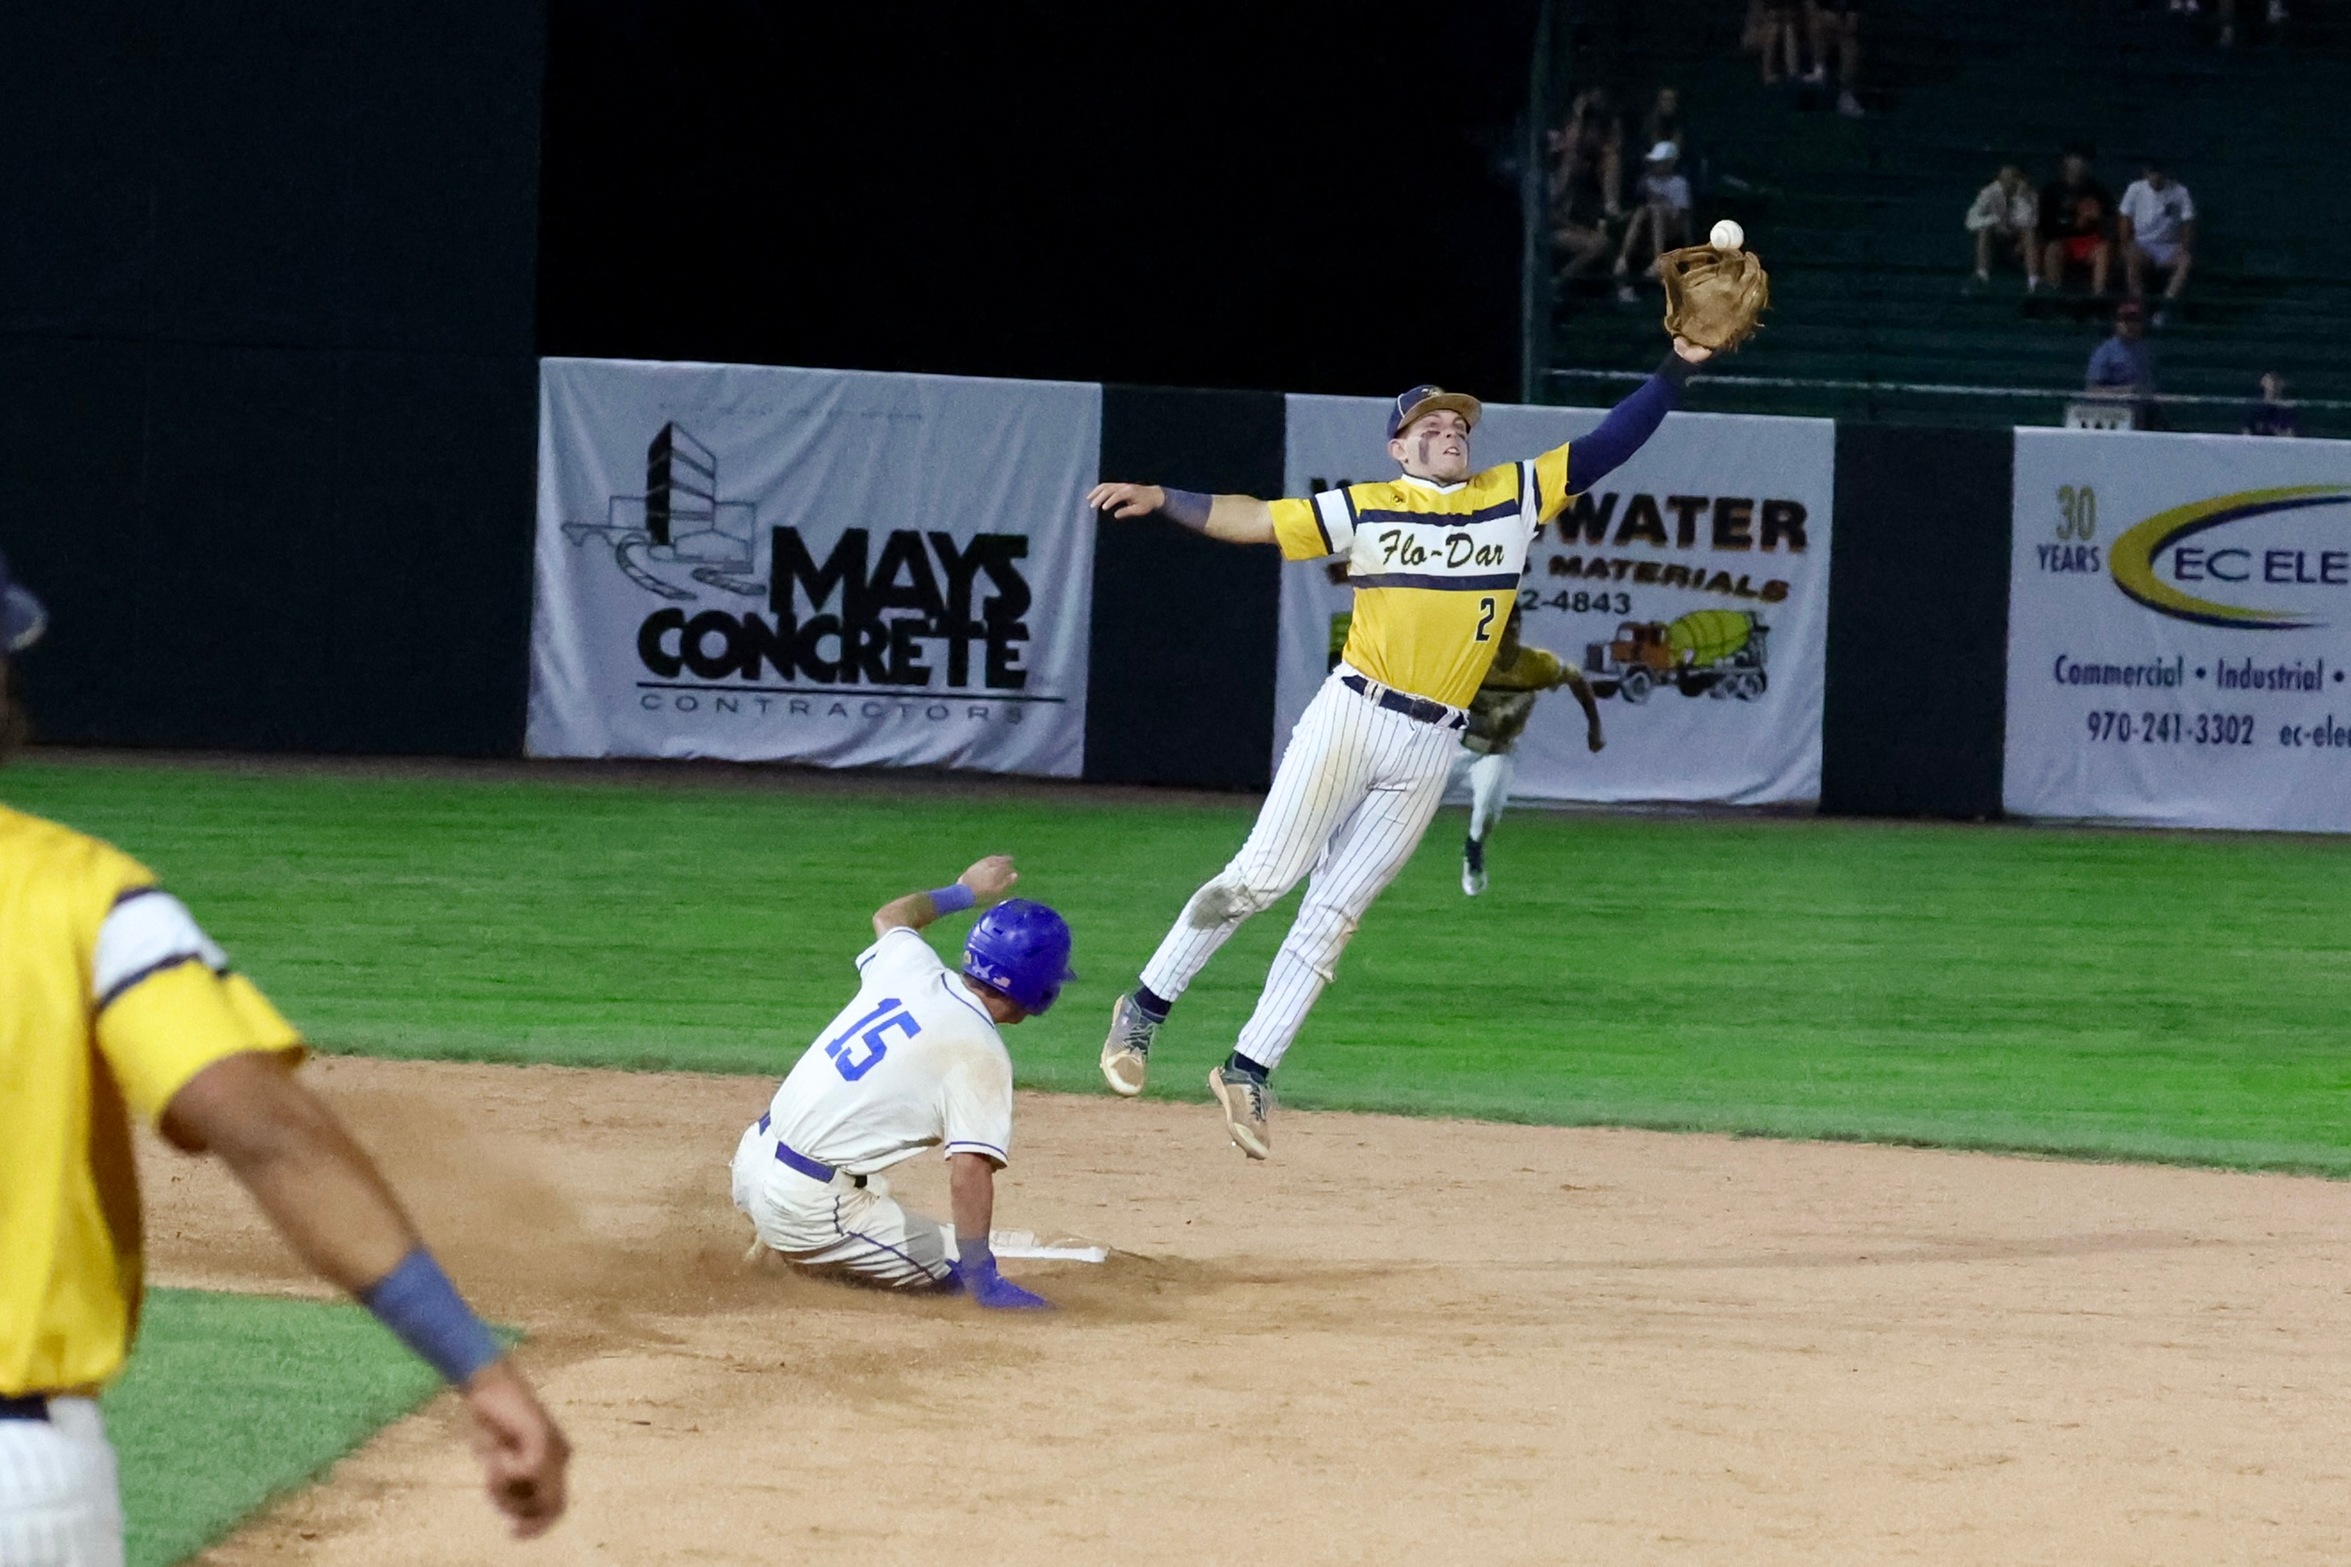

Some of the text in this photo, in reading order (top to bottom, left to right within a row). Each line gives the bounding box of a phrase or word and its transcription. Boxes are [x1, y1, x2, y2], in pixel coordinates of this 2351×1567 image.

[1533, 491, 1808, 553] WATER
[2055, 484, 2097, 541] 30
[1379, 529, 1504, 569] Flo-Dar
[2037, 543, 2101, 573] YEARS
[2174, 547, 2350, 585] EC ELE
[770, 525, 1031, 622] MAYS
[1548, 554, 1790, 604] MATERIALS
[1475, 596, 1496, 642] 2
[1520, 588, 1632, 615] 2-4843
[637, 607, 1030, 689] CONCRETE
[2055, 654, 2324, 692] Commercial Industrial
[640, 693, 1024, 726] CONTRACTORS
[2088, 711, 2351, 747] 970-241-3302 ec-ele
[824, 997, 922, 1083] 15
